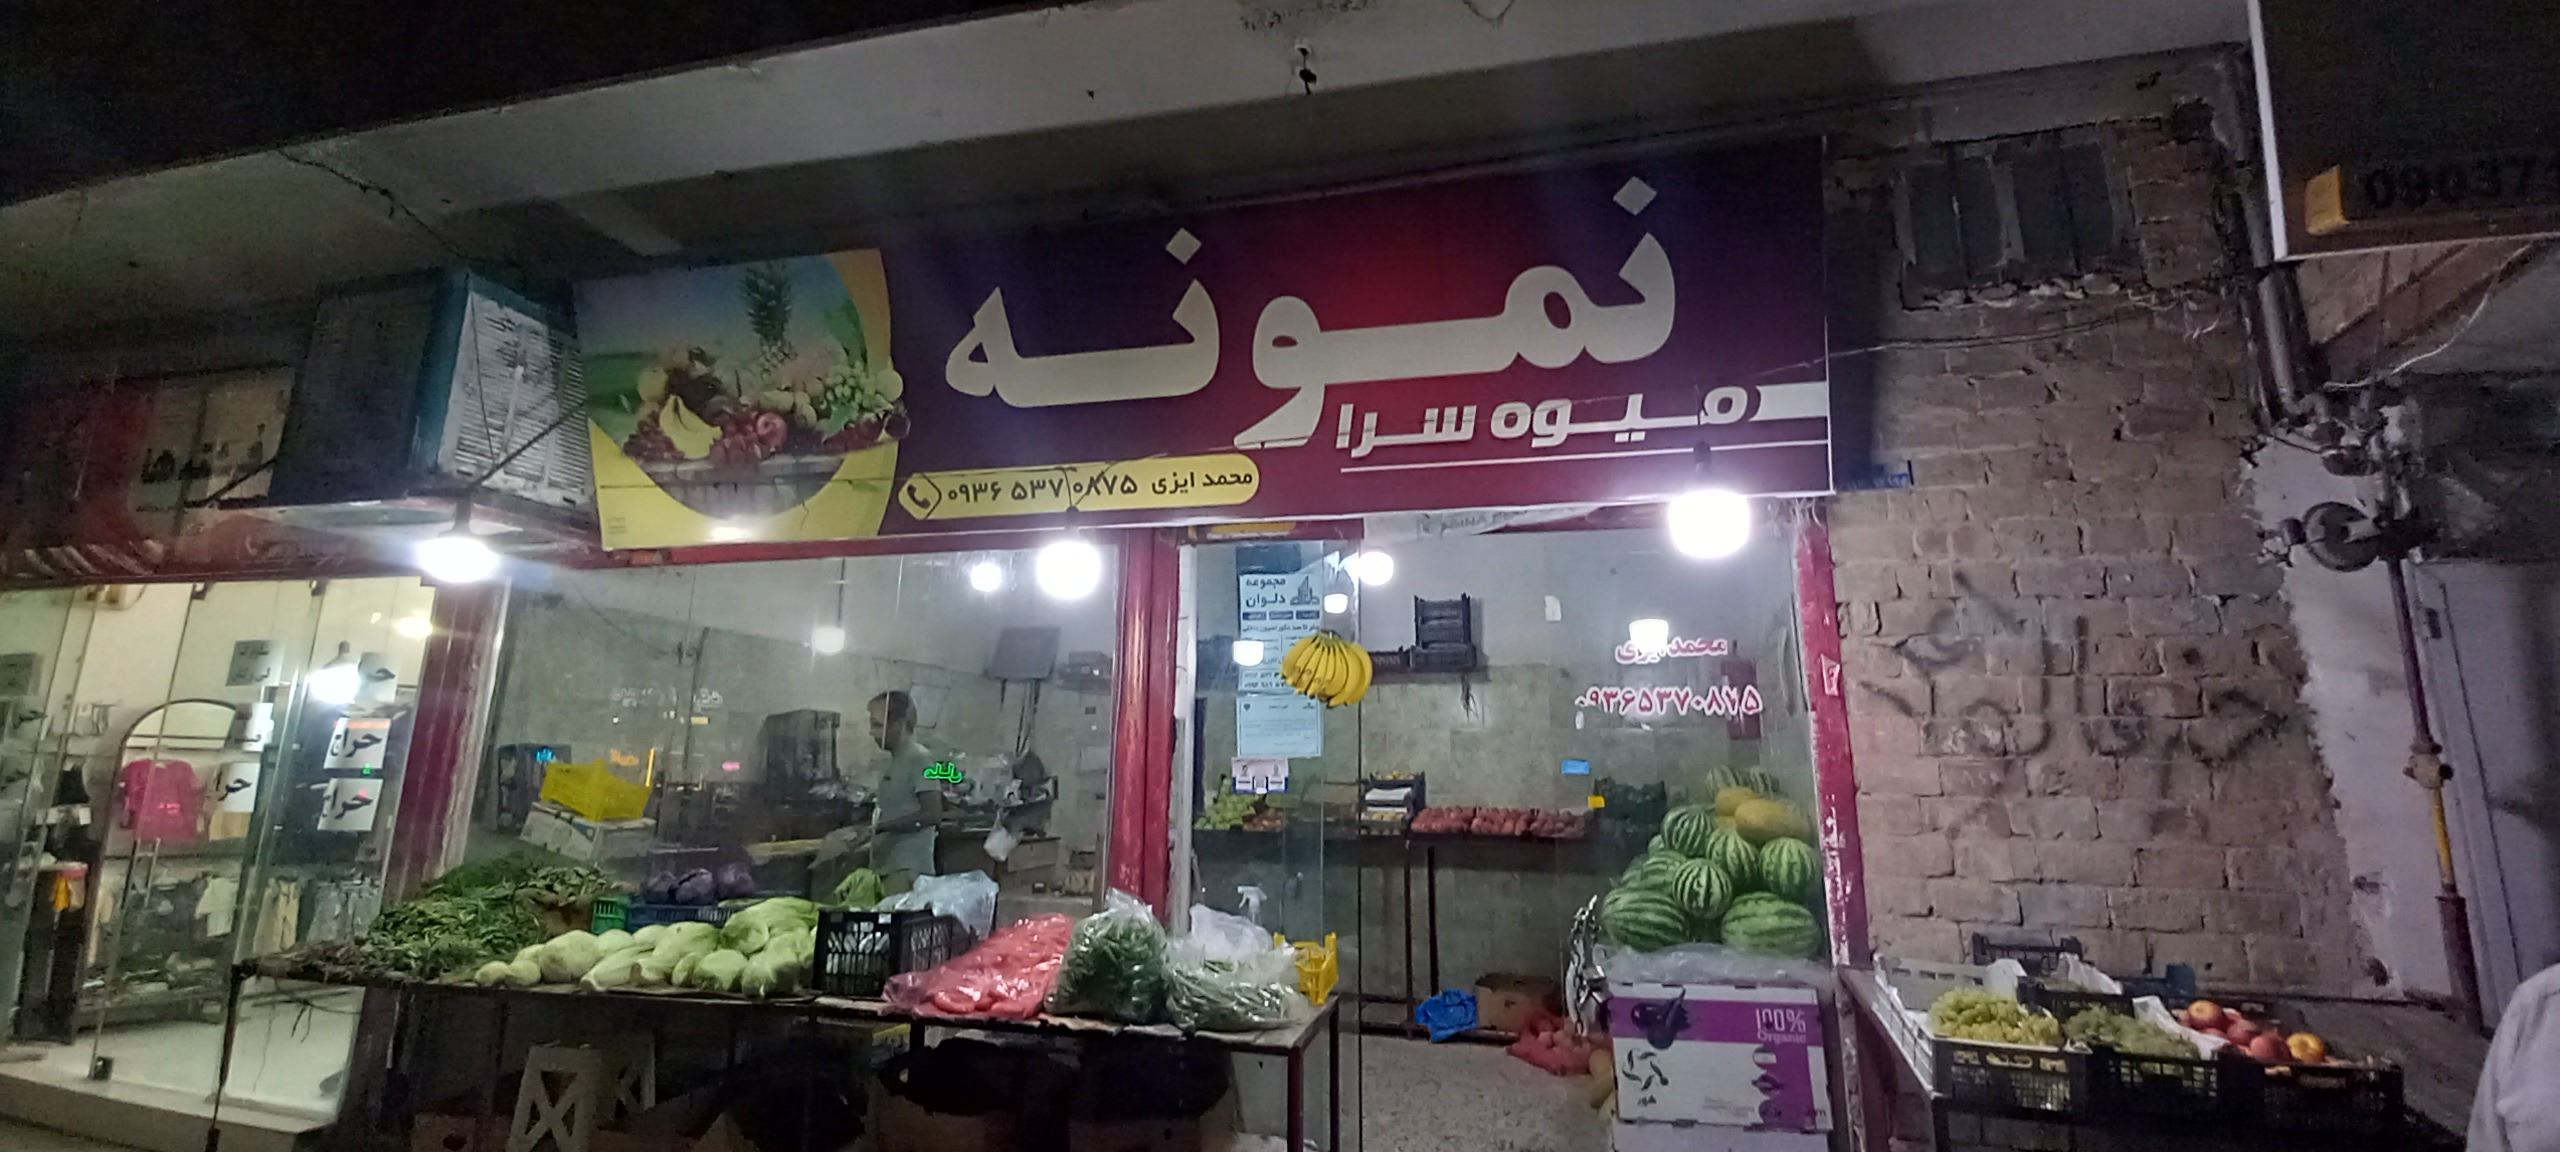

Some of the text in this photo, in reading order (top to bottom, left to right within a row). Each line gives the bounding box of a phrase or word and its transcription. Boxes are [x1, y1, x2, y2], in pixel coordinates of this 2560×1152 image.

[945, 175, 1677, 449] نمونه
[1334, 385, 1749, 458] میوه سرا
[947, 470, 1253, 504] محمد ایزی ۰۹۳۶ ۵۳۷ ۰۸۷۵
[1246, 578, 1286, 589] مجموعه
[1246, 592, 1286, 608] دلوان
[1668, 636, 1729, 657] محمد
[330, 728, 383, 758] حراج
[1756, 1007, 1806, 1033] 100%
